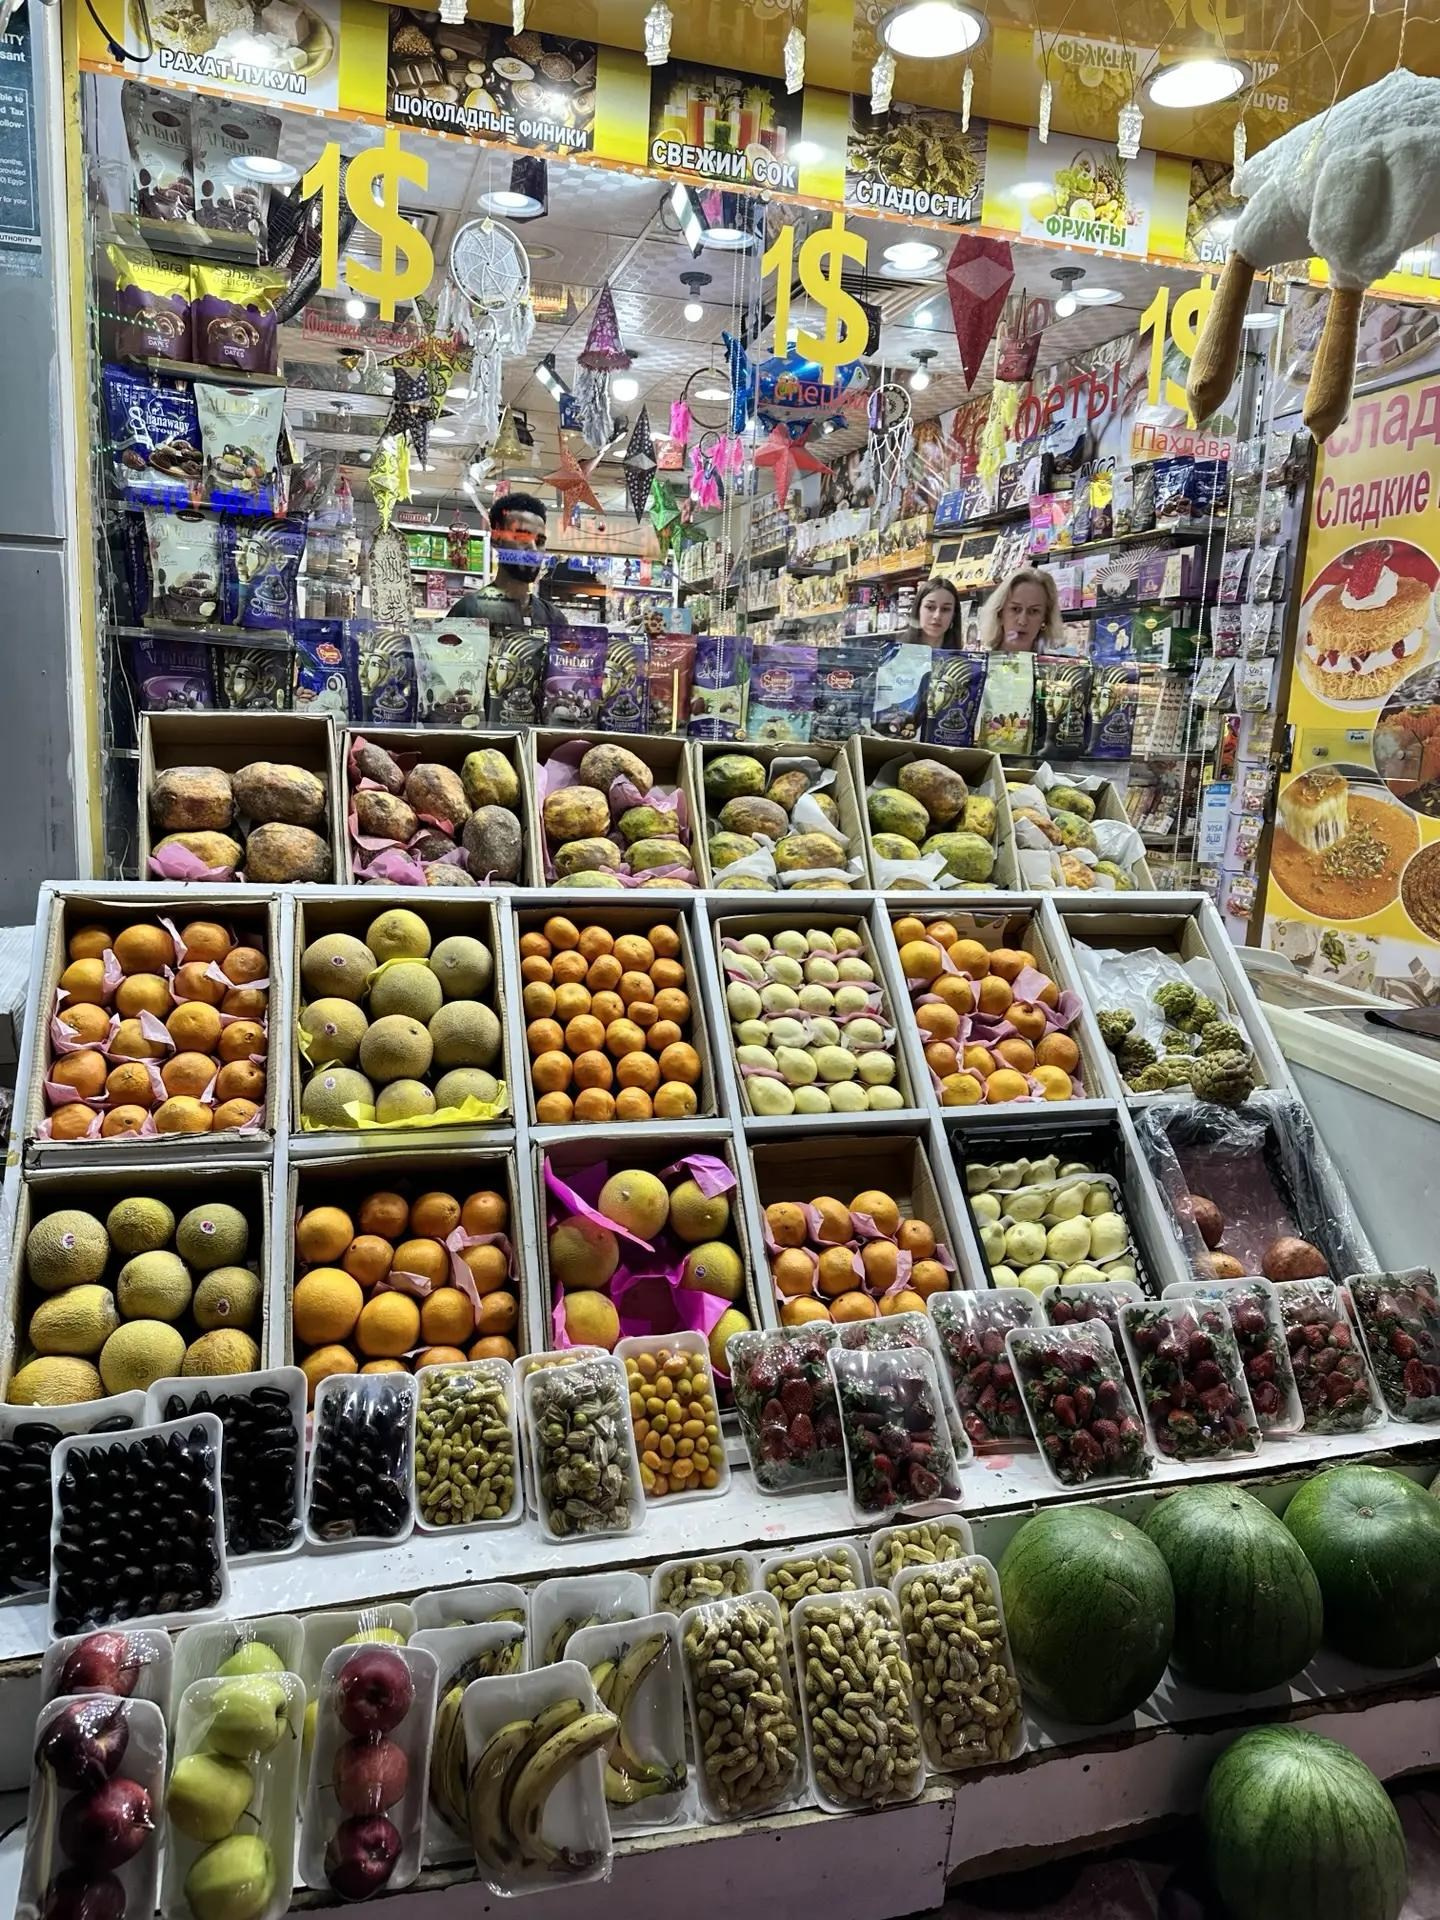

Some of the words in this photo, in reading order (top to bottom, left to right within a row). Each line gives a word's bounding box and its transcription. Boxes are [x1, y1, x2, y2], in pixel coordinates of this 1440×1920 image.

[160, 48, 231, 79] РАХАТ
[235, 63, 306, 94] ЛУКУМ
[10, 107, 24, 116] Tax
[394, 93, 515, 134] ШОКОЛАДНЫЕ
[519, 118, 586, 149] ФИНИКИ
[652, 138, 746, 179] СВЕЖИЙ
[752, 157, 796, 188] СОК
[856, 180, 972, 220] СЛАДОСТИ
[302, 128, 434, 323] 1$
[1045, 215, 1127, 248] ФРУКТЫ
[215, 265, 263, 284] Sahara
[1200, 239, 1230, 264] БА
[761, 210, 869, 386] 1$
[1316, 470, 1430, 531] Сладкие
